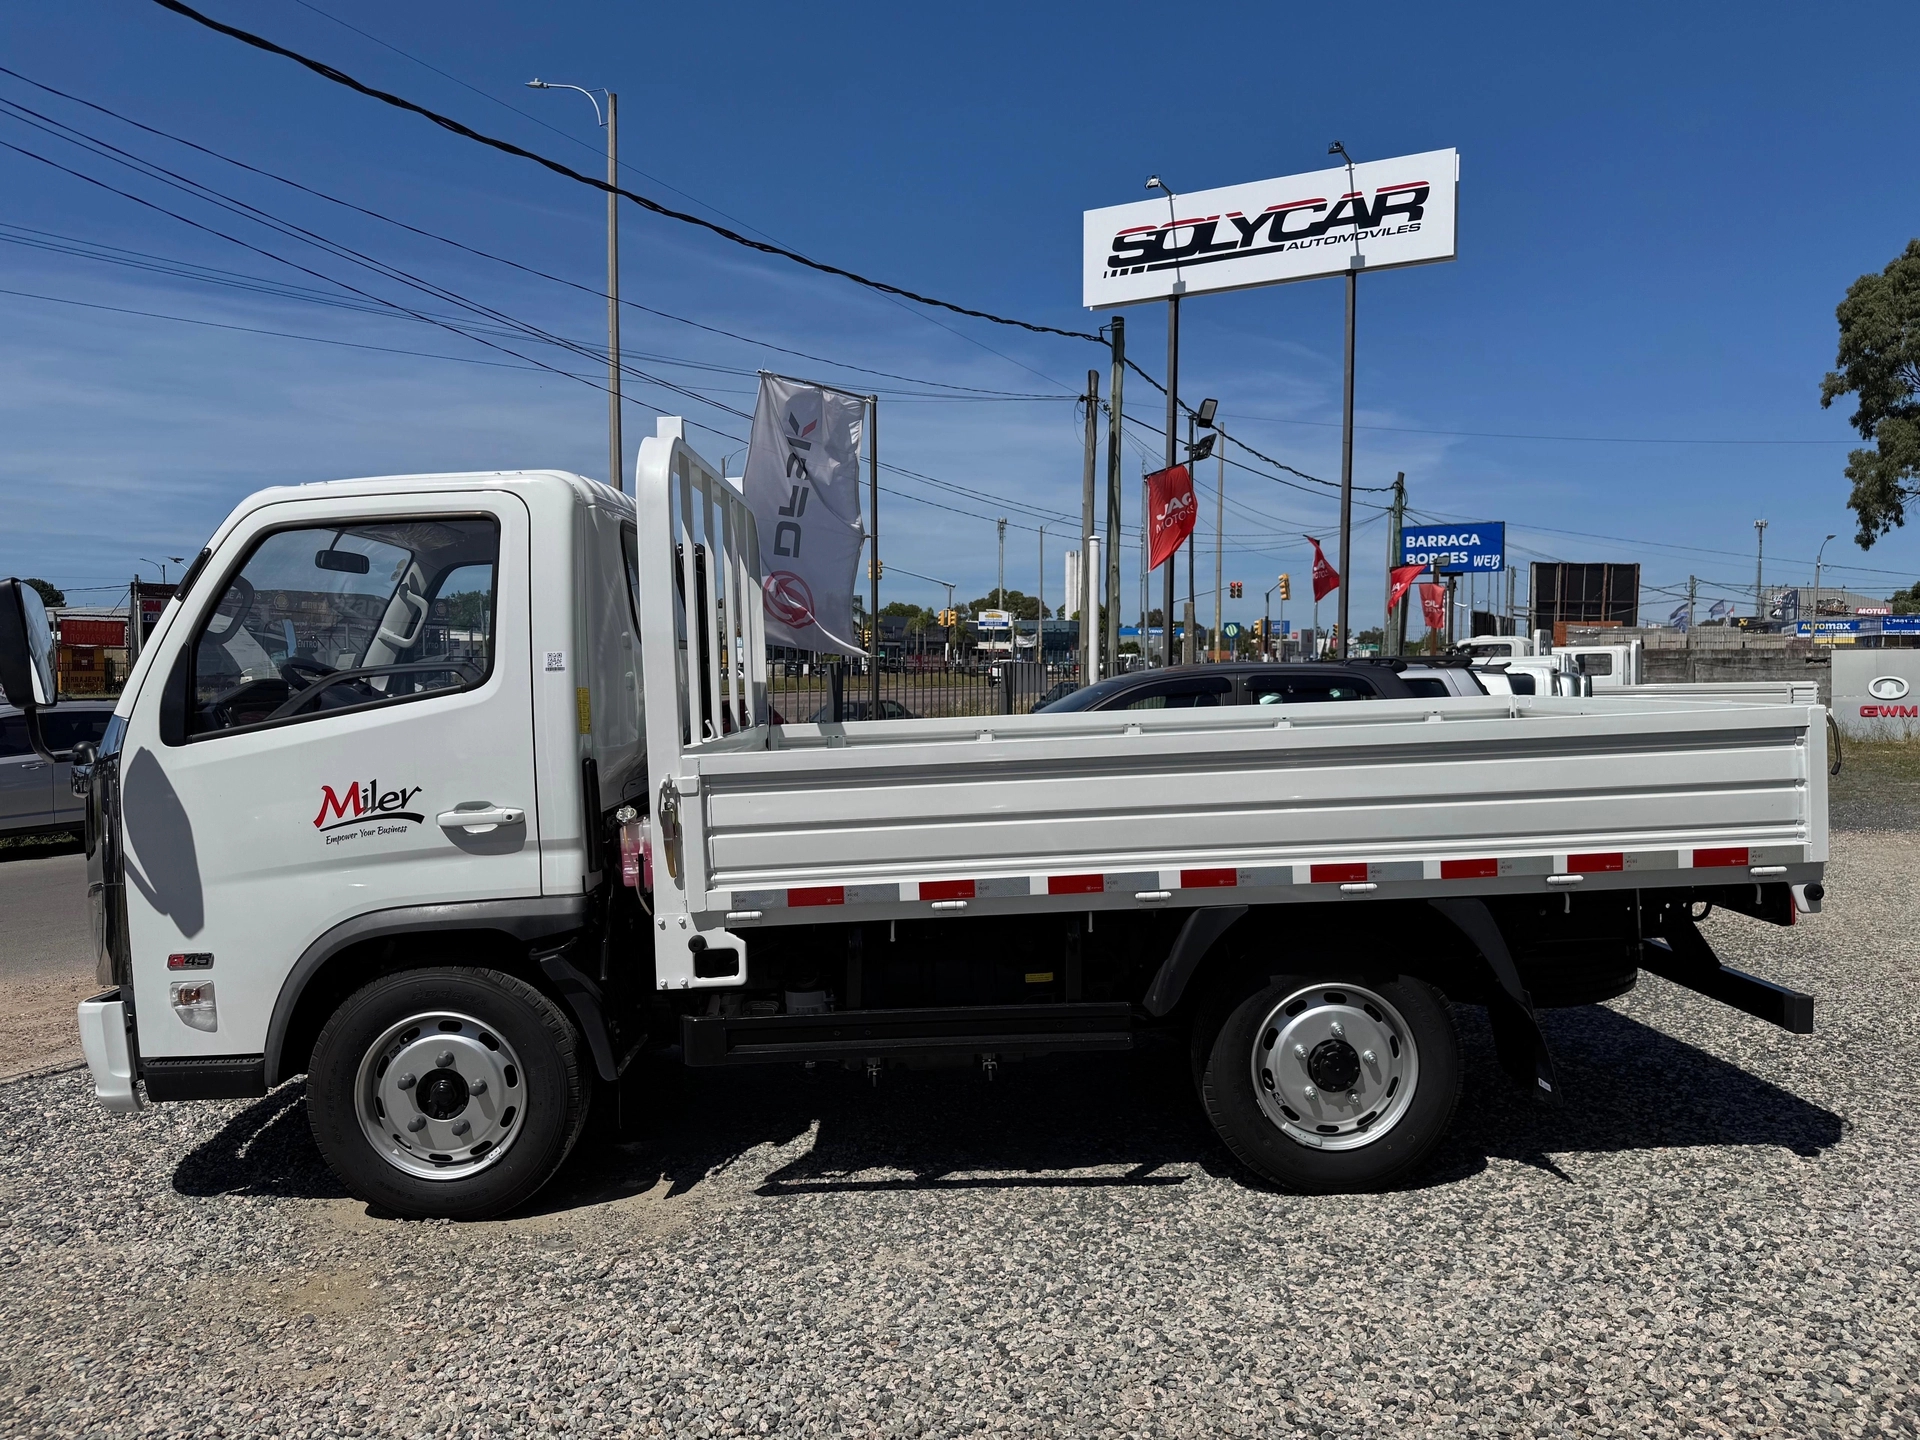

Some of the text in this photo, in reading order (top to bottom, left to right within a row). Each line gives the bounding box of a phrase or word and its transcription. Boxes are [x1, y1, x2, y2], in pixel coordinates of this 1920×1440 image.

[1107, 180, 1431, 269] SOLYCAR
[1286, 222, 1421, 252] AUTOMOVILES
[1405, 533, 1481, 548] BARRACA
[1473, 554, 1500, 570] WEB
[1859, 705, 1918, 718] GWM
[313, 779, 423, 828] Miler
[326, 825, 408, 845] Empower Your Business
